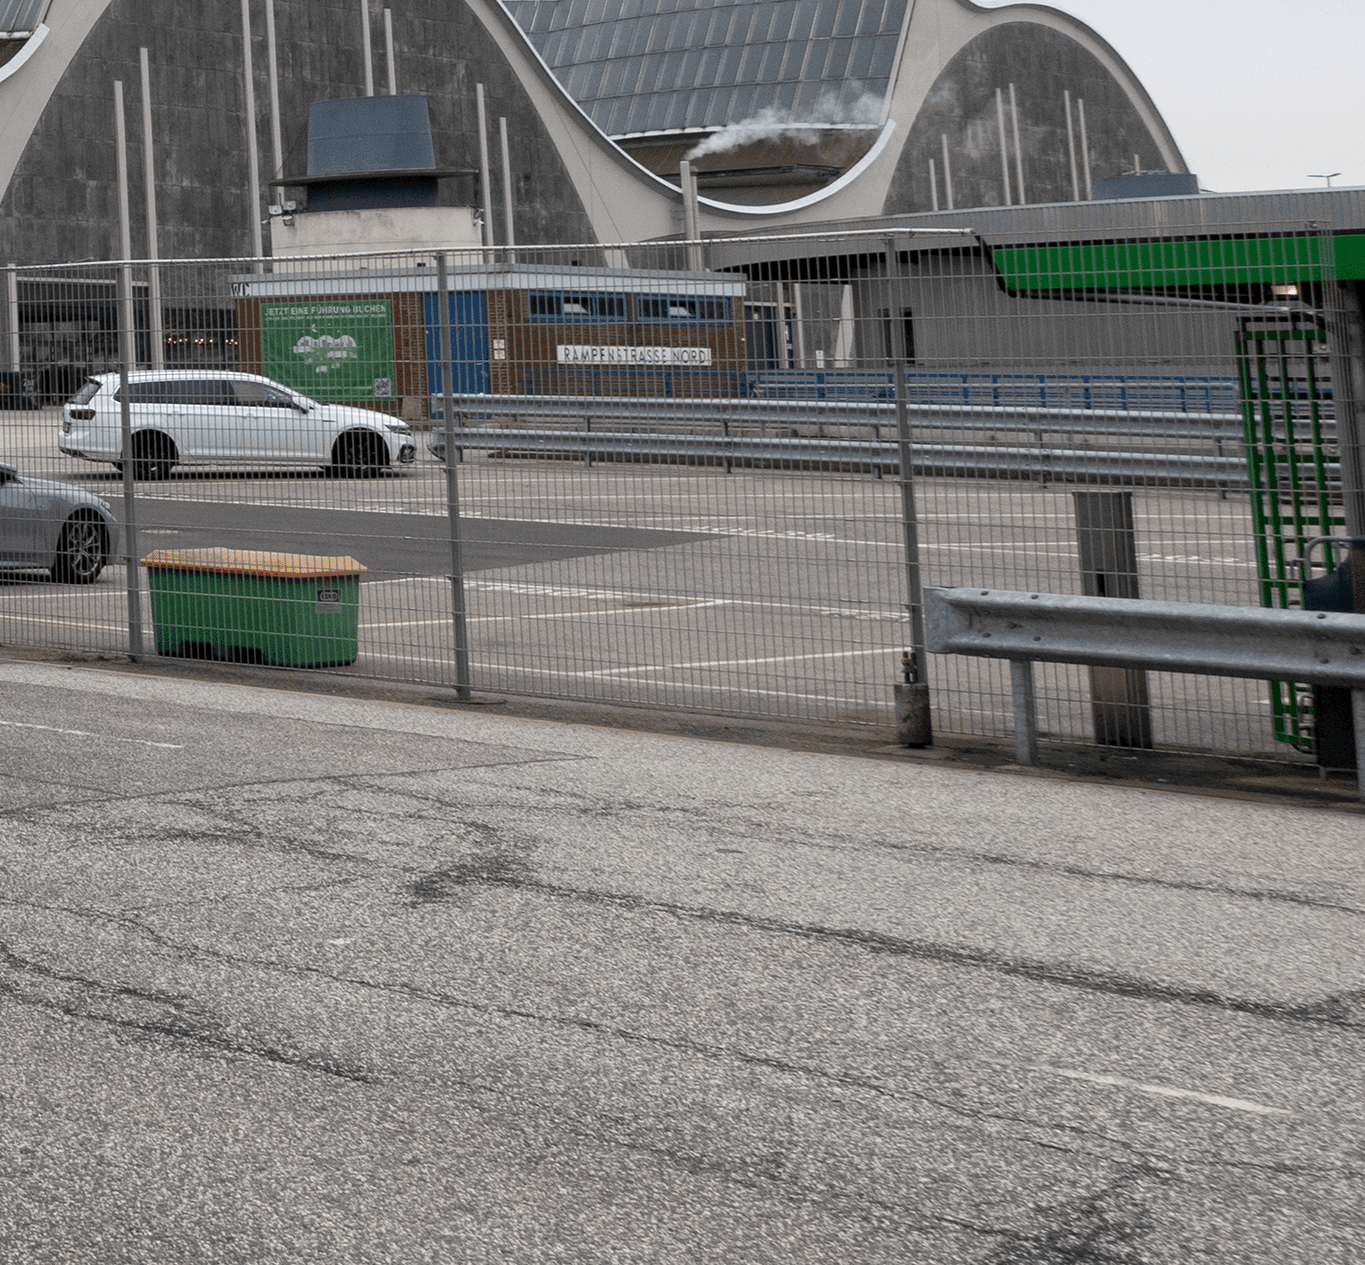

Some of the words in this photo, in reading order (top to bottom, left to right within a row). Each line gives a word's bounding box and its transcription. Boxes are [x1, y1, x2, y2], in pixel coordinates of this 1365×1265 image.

[231, 283, 250, 296] WC
[265, 307, 288, 316] JETZT
[291, 307, 309, 315] EINE
[311, 305, 351, 314] FÜHRUNG
[353, 305, 386, 313] BUCHEN
[564, 348, 667, 364] RAMPENSTRASSE
[671, 349, 706, 364] NORD
